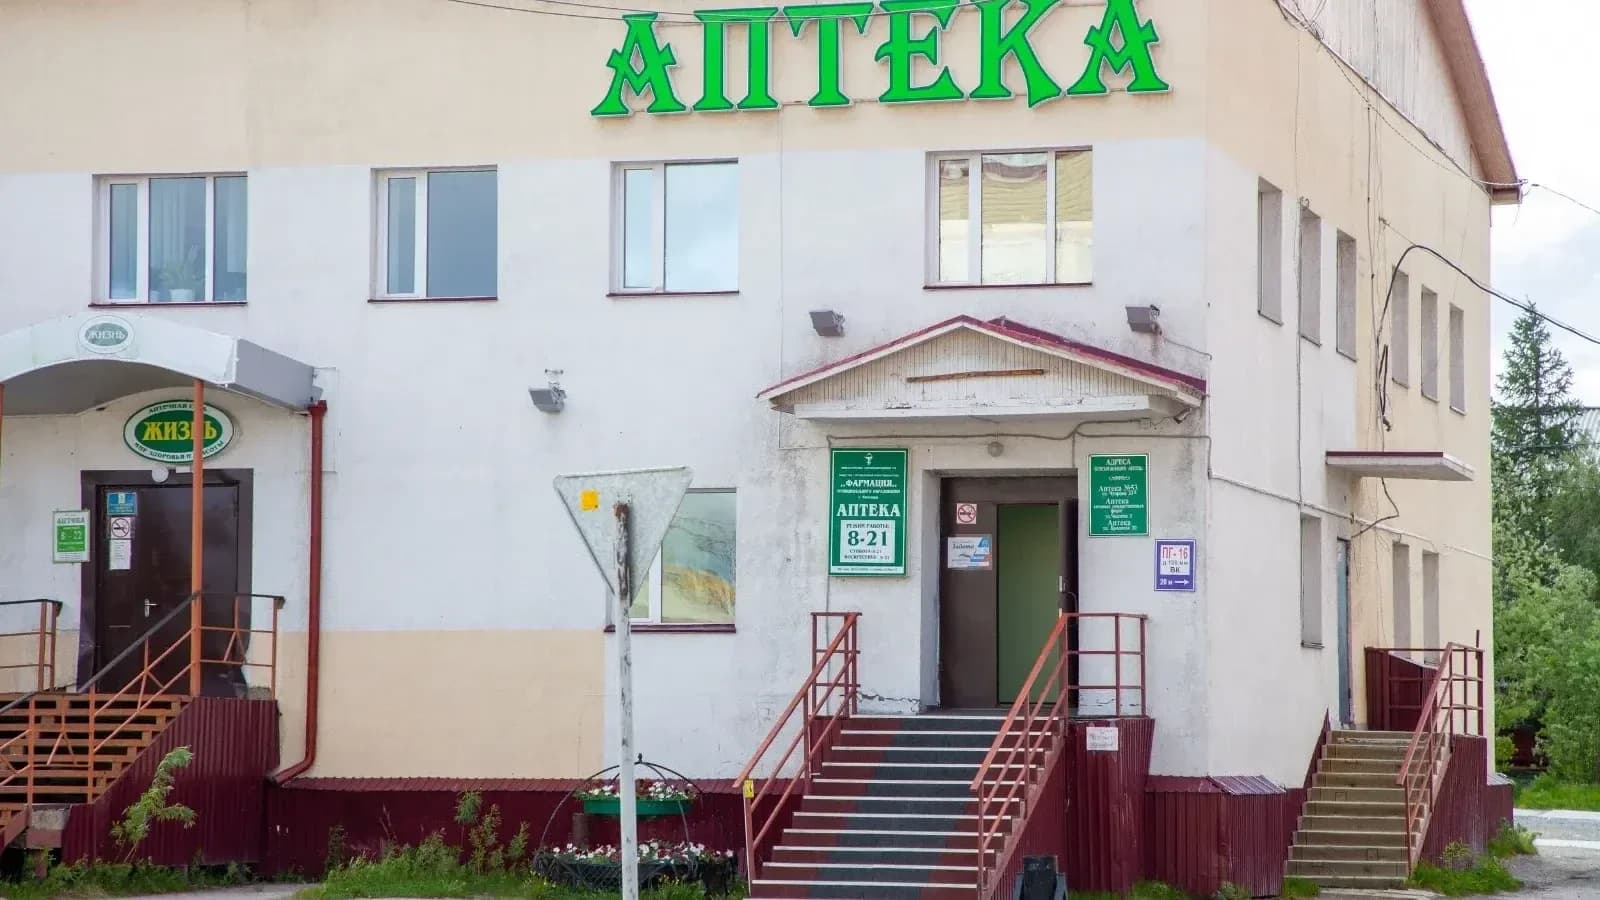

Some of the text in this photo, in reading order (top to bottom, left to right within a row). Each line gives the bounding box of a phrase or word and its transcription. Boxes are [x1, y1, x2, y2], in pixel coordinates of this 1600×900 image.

[591, 0, 1172, 117] АПТЕКА
[88, 330, 126, 340] ЖИЗНЬ
[142, 421, 218, 441] ЖИЗЬ
[1105, 458, 1132, 466] АДРЕСА
[836, 503, 901, 517] АПТЕКА
[847, 530, 888, 547] 8-21
